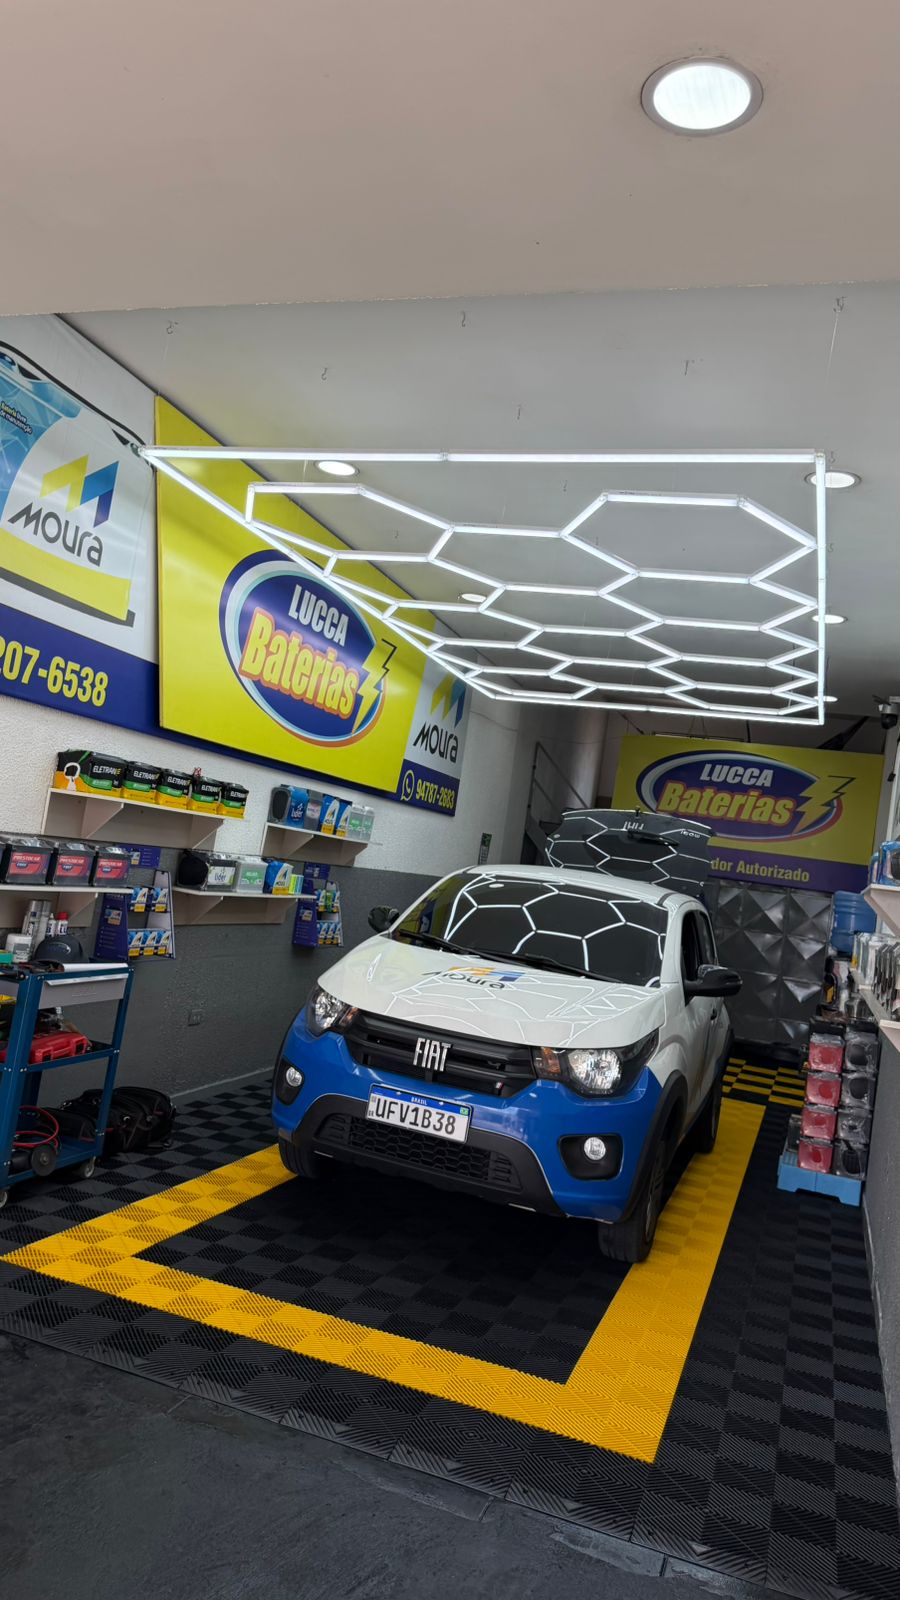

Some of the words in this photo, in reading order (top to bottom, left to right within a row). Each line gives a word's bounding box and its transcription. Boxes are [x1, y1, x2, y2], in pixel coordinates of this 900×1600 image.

[288, 584, 349, 647] LUCCA
[239, 608, 358, 719] Baterias
[700, 763, 774, 787] LUCCA
[656, 781, 795, 826] Baterias
[736, 860, 810, 883] Autorizado
[413, 1037, 452, 1072] FIAT
[375, 1097, 457, 1135] UFV1B38
